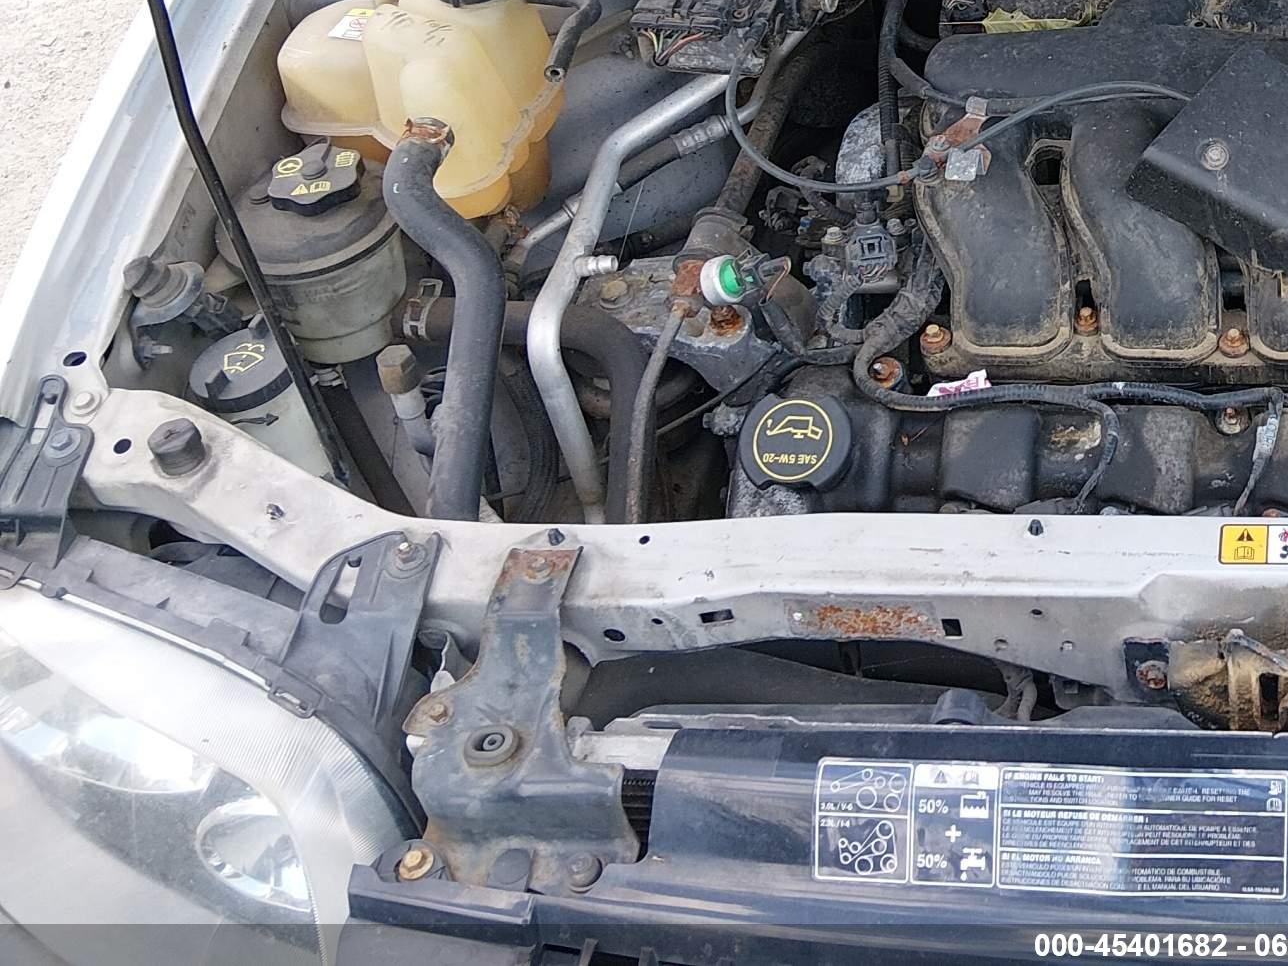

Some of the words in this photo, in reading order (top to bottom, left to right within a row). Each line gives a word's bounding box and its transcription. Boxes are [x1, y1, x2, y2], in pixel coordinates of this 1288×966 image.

[763, 452, 796, 464] 5W-20
[797, 453, 818, 465] SAE
[1044, 773, 1065, 782] FAILS
[1066, 774, 1077, 782] TO
[918, 798, 949, 814] 50%
[1023, 809, 1057, 819] MOTEUR
[1057, 810, 1088, 820] REFUSE
[916, 853, 947, 869] 50%
[1022, 853, 1051, 862] MOTOR
[1064, 855, 1102, 865] ARRANCA
